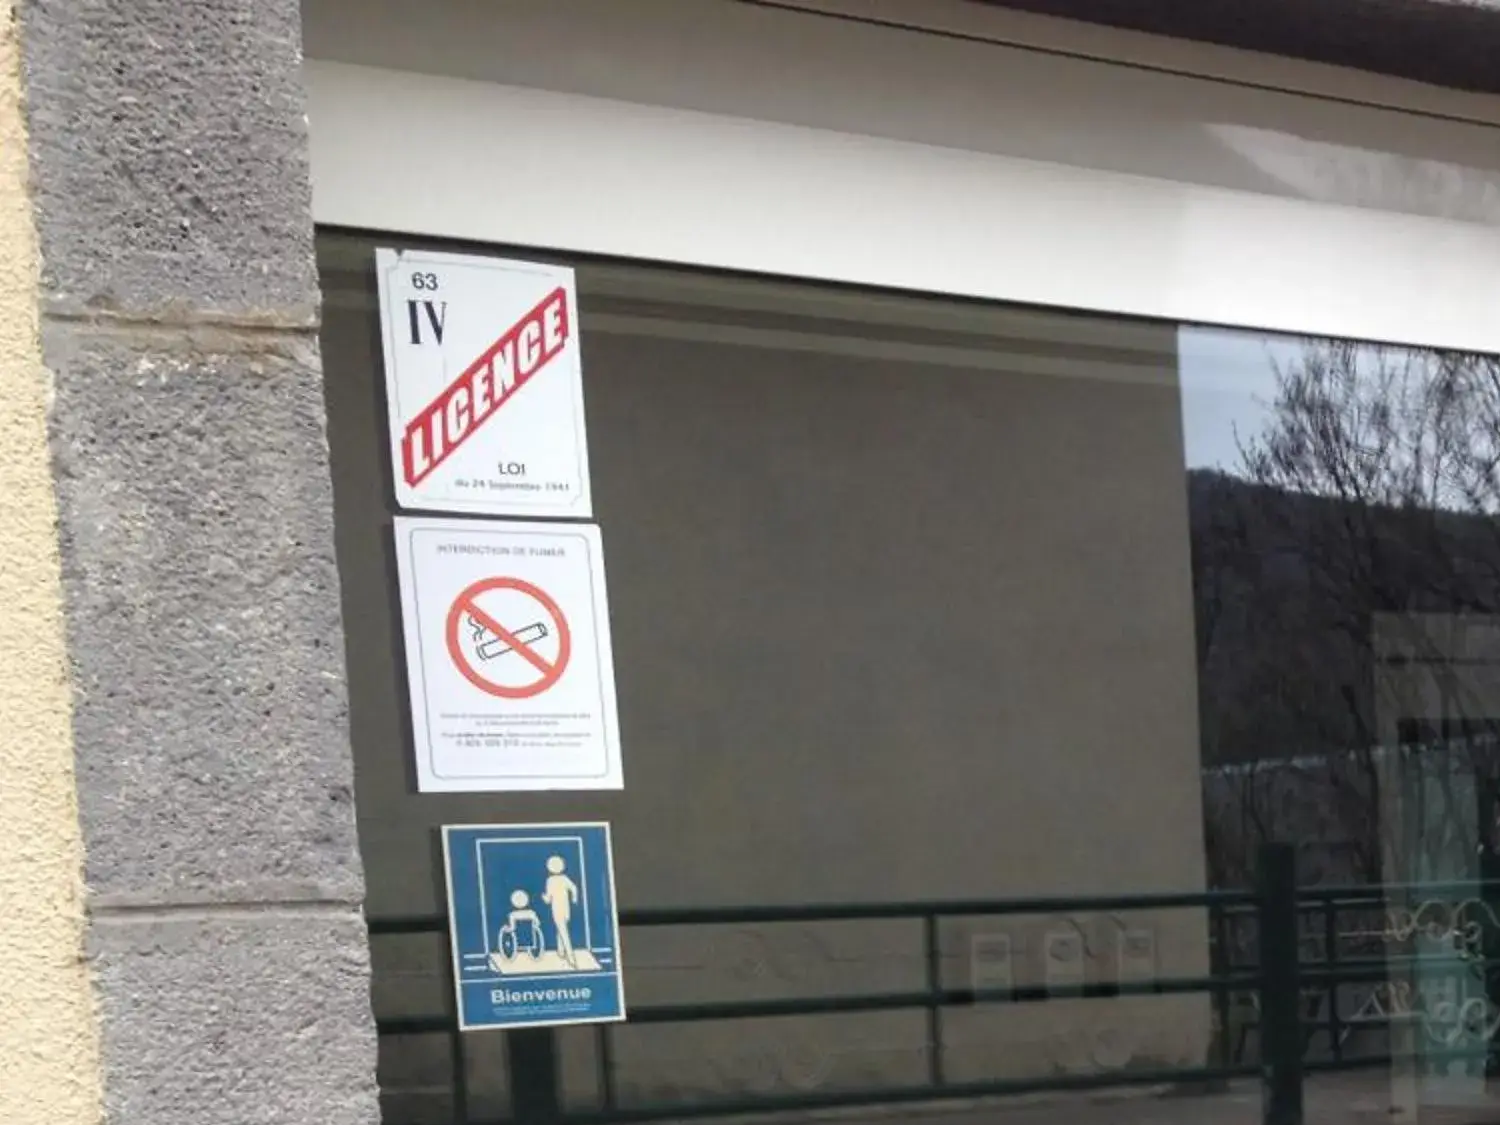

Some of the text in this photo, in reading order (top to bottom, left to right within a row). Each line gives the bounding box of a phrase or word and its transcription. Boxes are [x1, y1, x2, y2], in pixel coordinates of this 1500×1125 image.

[411, 272, 438, 291] 63
[407, 299, 447, 346] IV
[409, 297, 565, 479] LICENCE
[498, 462, 526, 476] LOI
[490, 987, 593, 1004] Bienvenue
